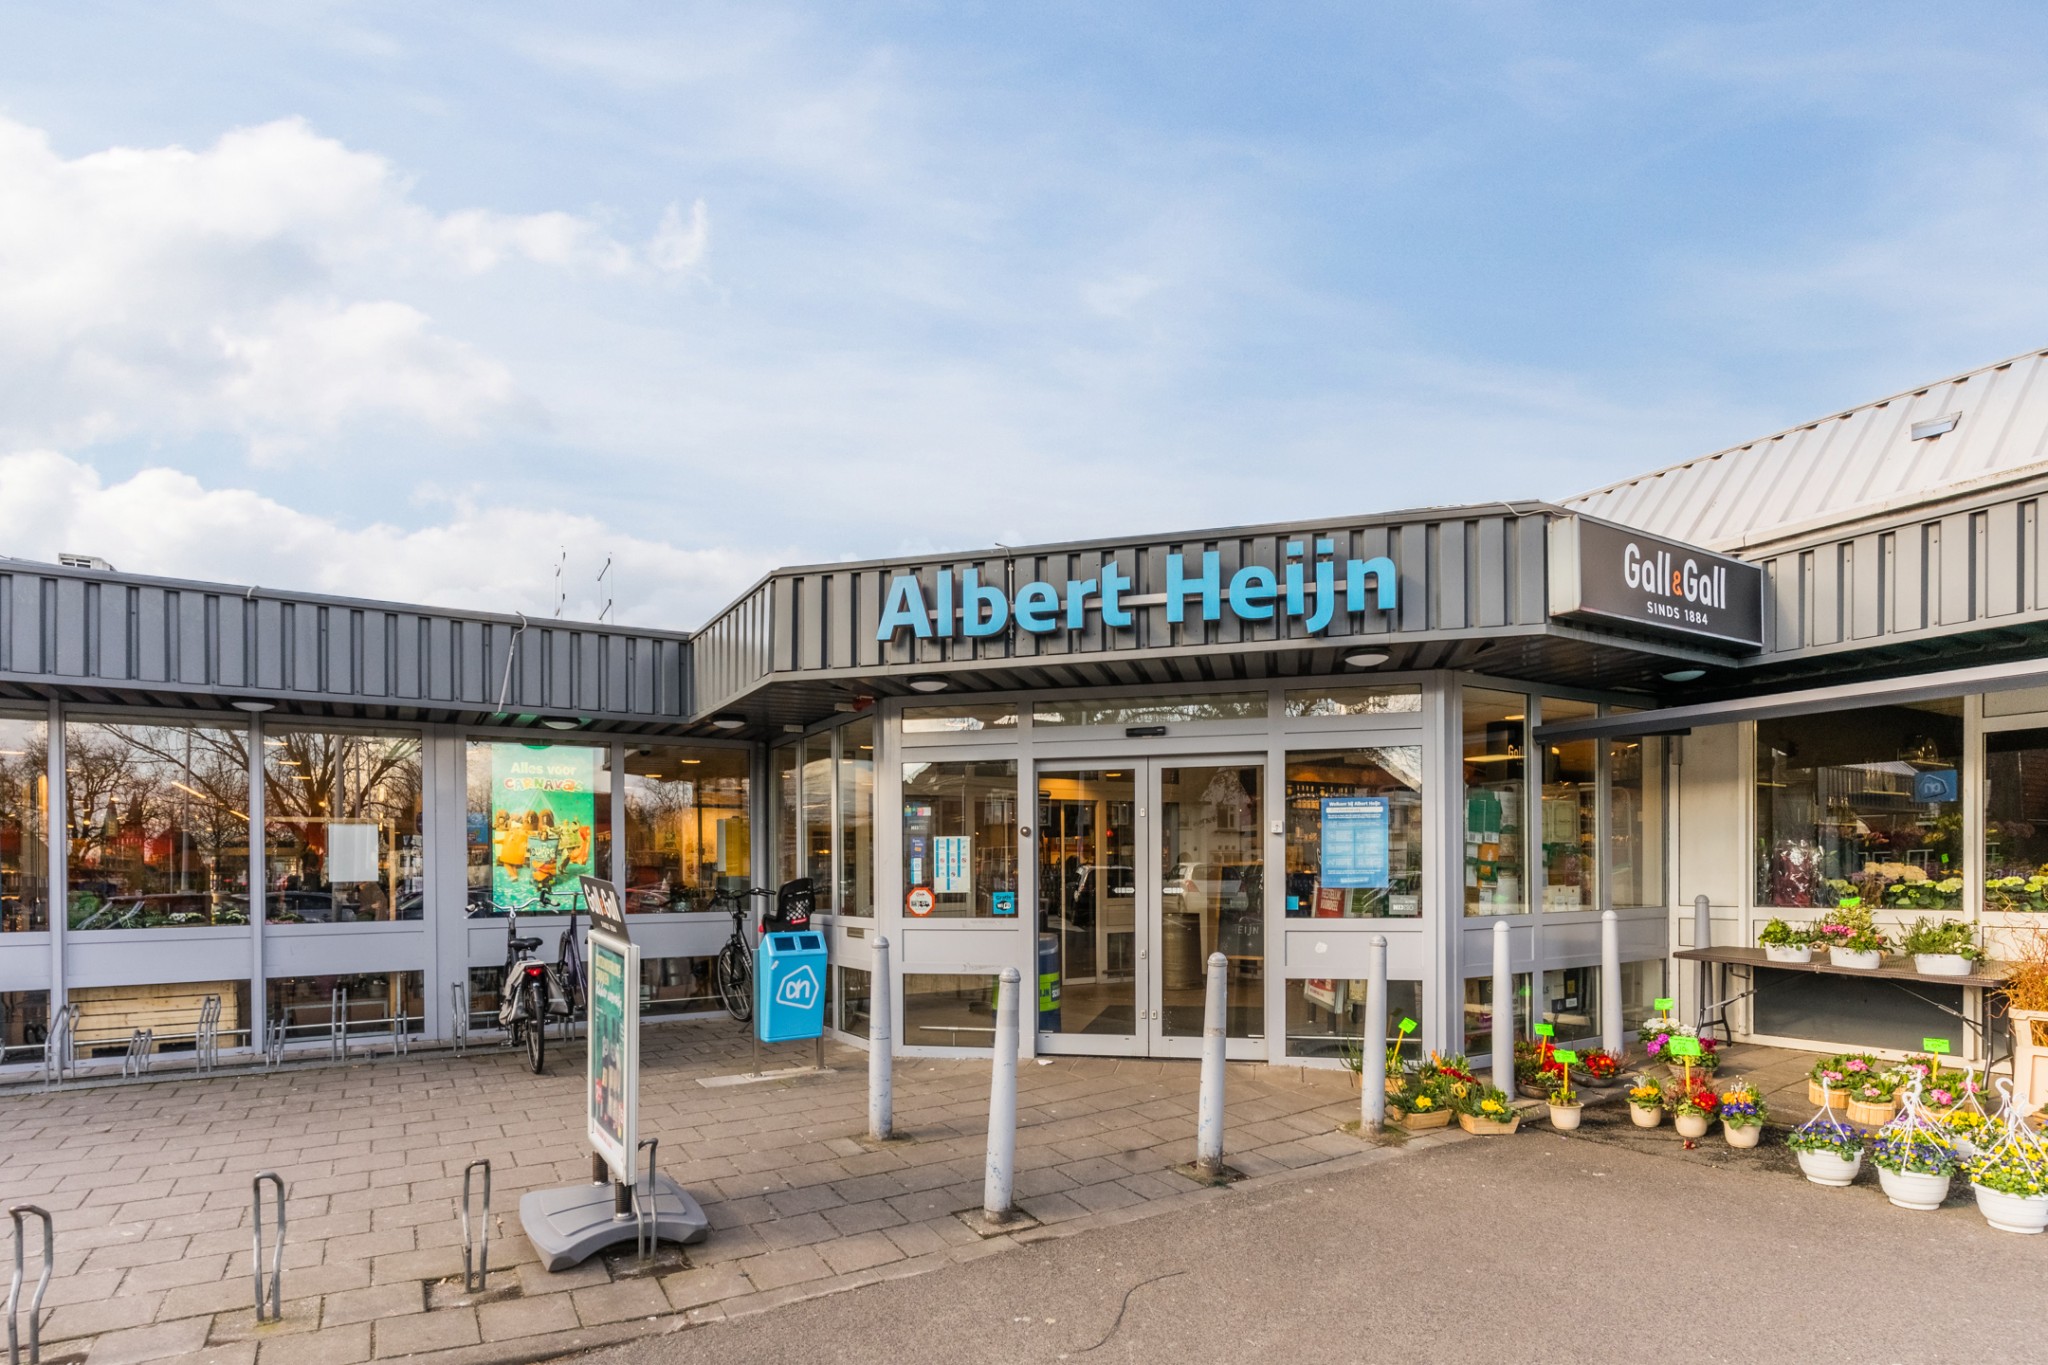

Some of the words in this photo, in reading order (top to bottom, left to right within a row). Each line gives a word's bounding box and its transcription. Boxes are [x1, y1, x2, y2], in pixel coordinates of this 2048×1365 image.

[876, 560, 1132, 643] Albert
[1166, 538, 1397, 634] Heijn
[1624, 542, 1727, 610] Gall&Gall
[1647, 601, 1680, 620] SINDS
[1684, 609, 1708, 626] 1884
[511, 762, 544, 774] Alles
[547, 764, 577, 776] voor
